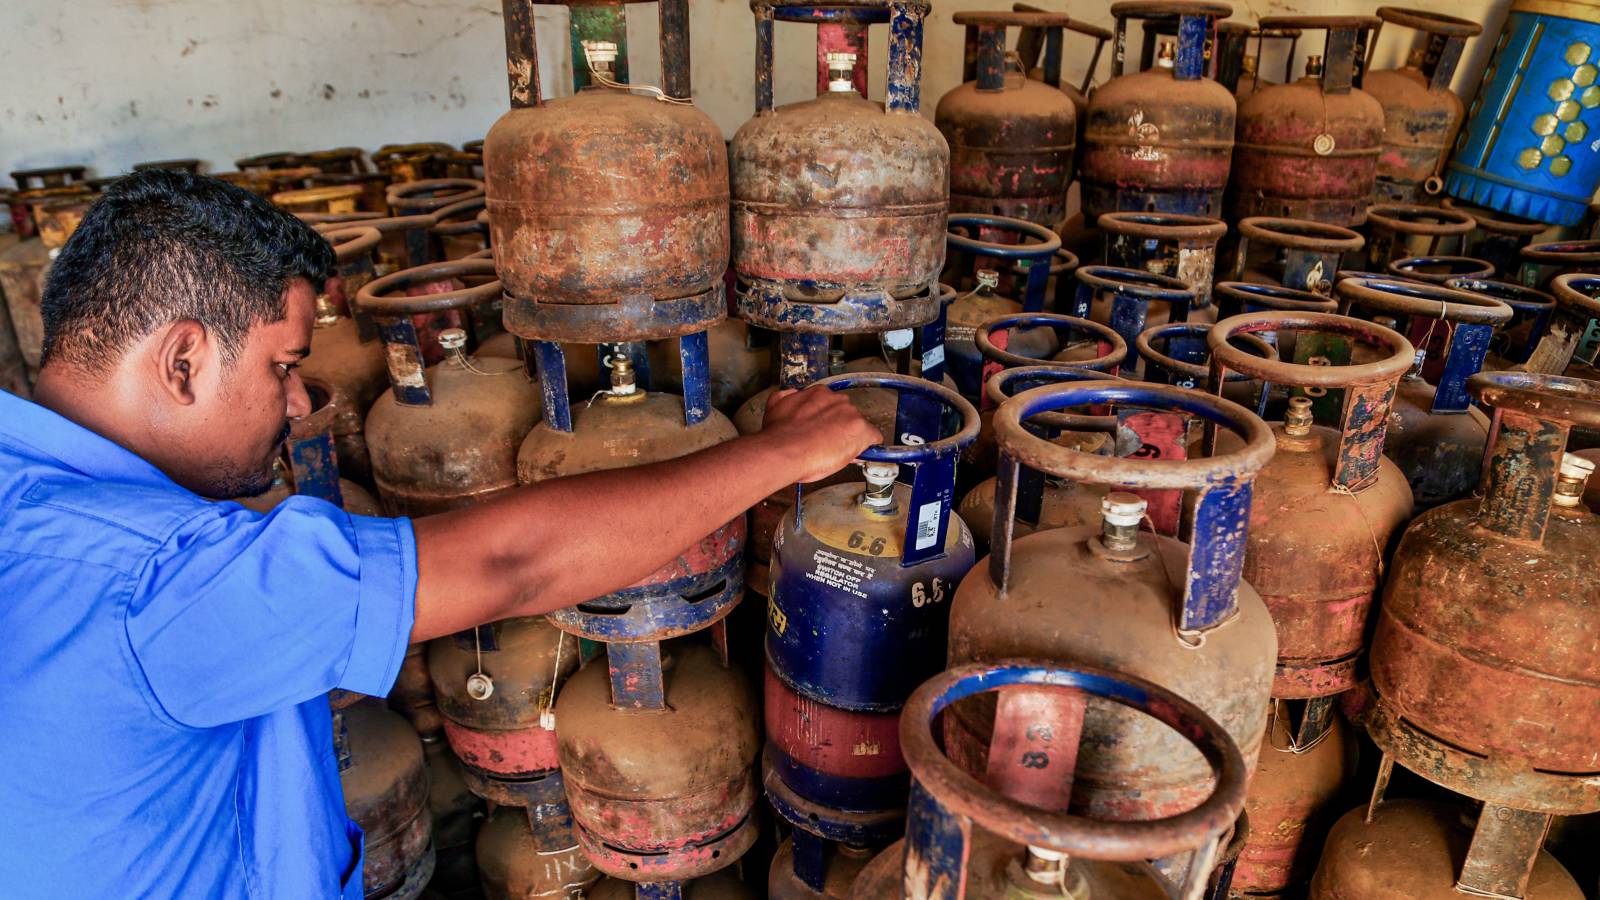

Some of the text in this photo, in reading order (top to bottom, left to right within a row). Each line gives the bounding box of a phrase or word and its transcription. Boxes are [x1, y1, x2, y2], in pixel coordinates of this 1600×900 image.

[847, 530, 886, 556] 6.6
[805, 571, 868, 599] WHEN NOT IN USE
[814, 569, 859, 589] REGULATOR
[816, 564, 862, 583] SWITCH OFF
[911, 577, 944, 608] 6.6
